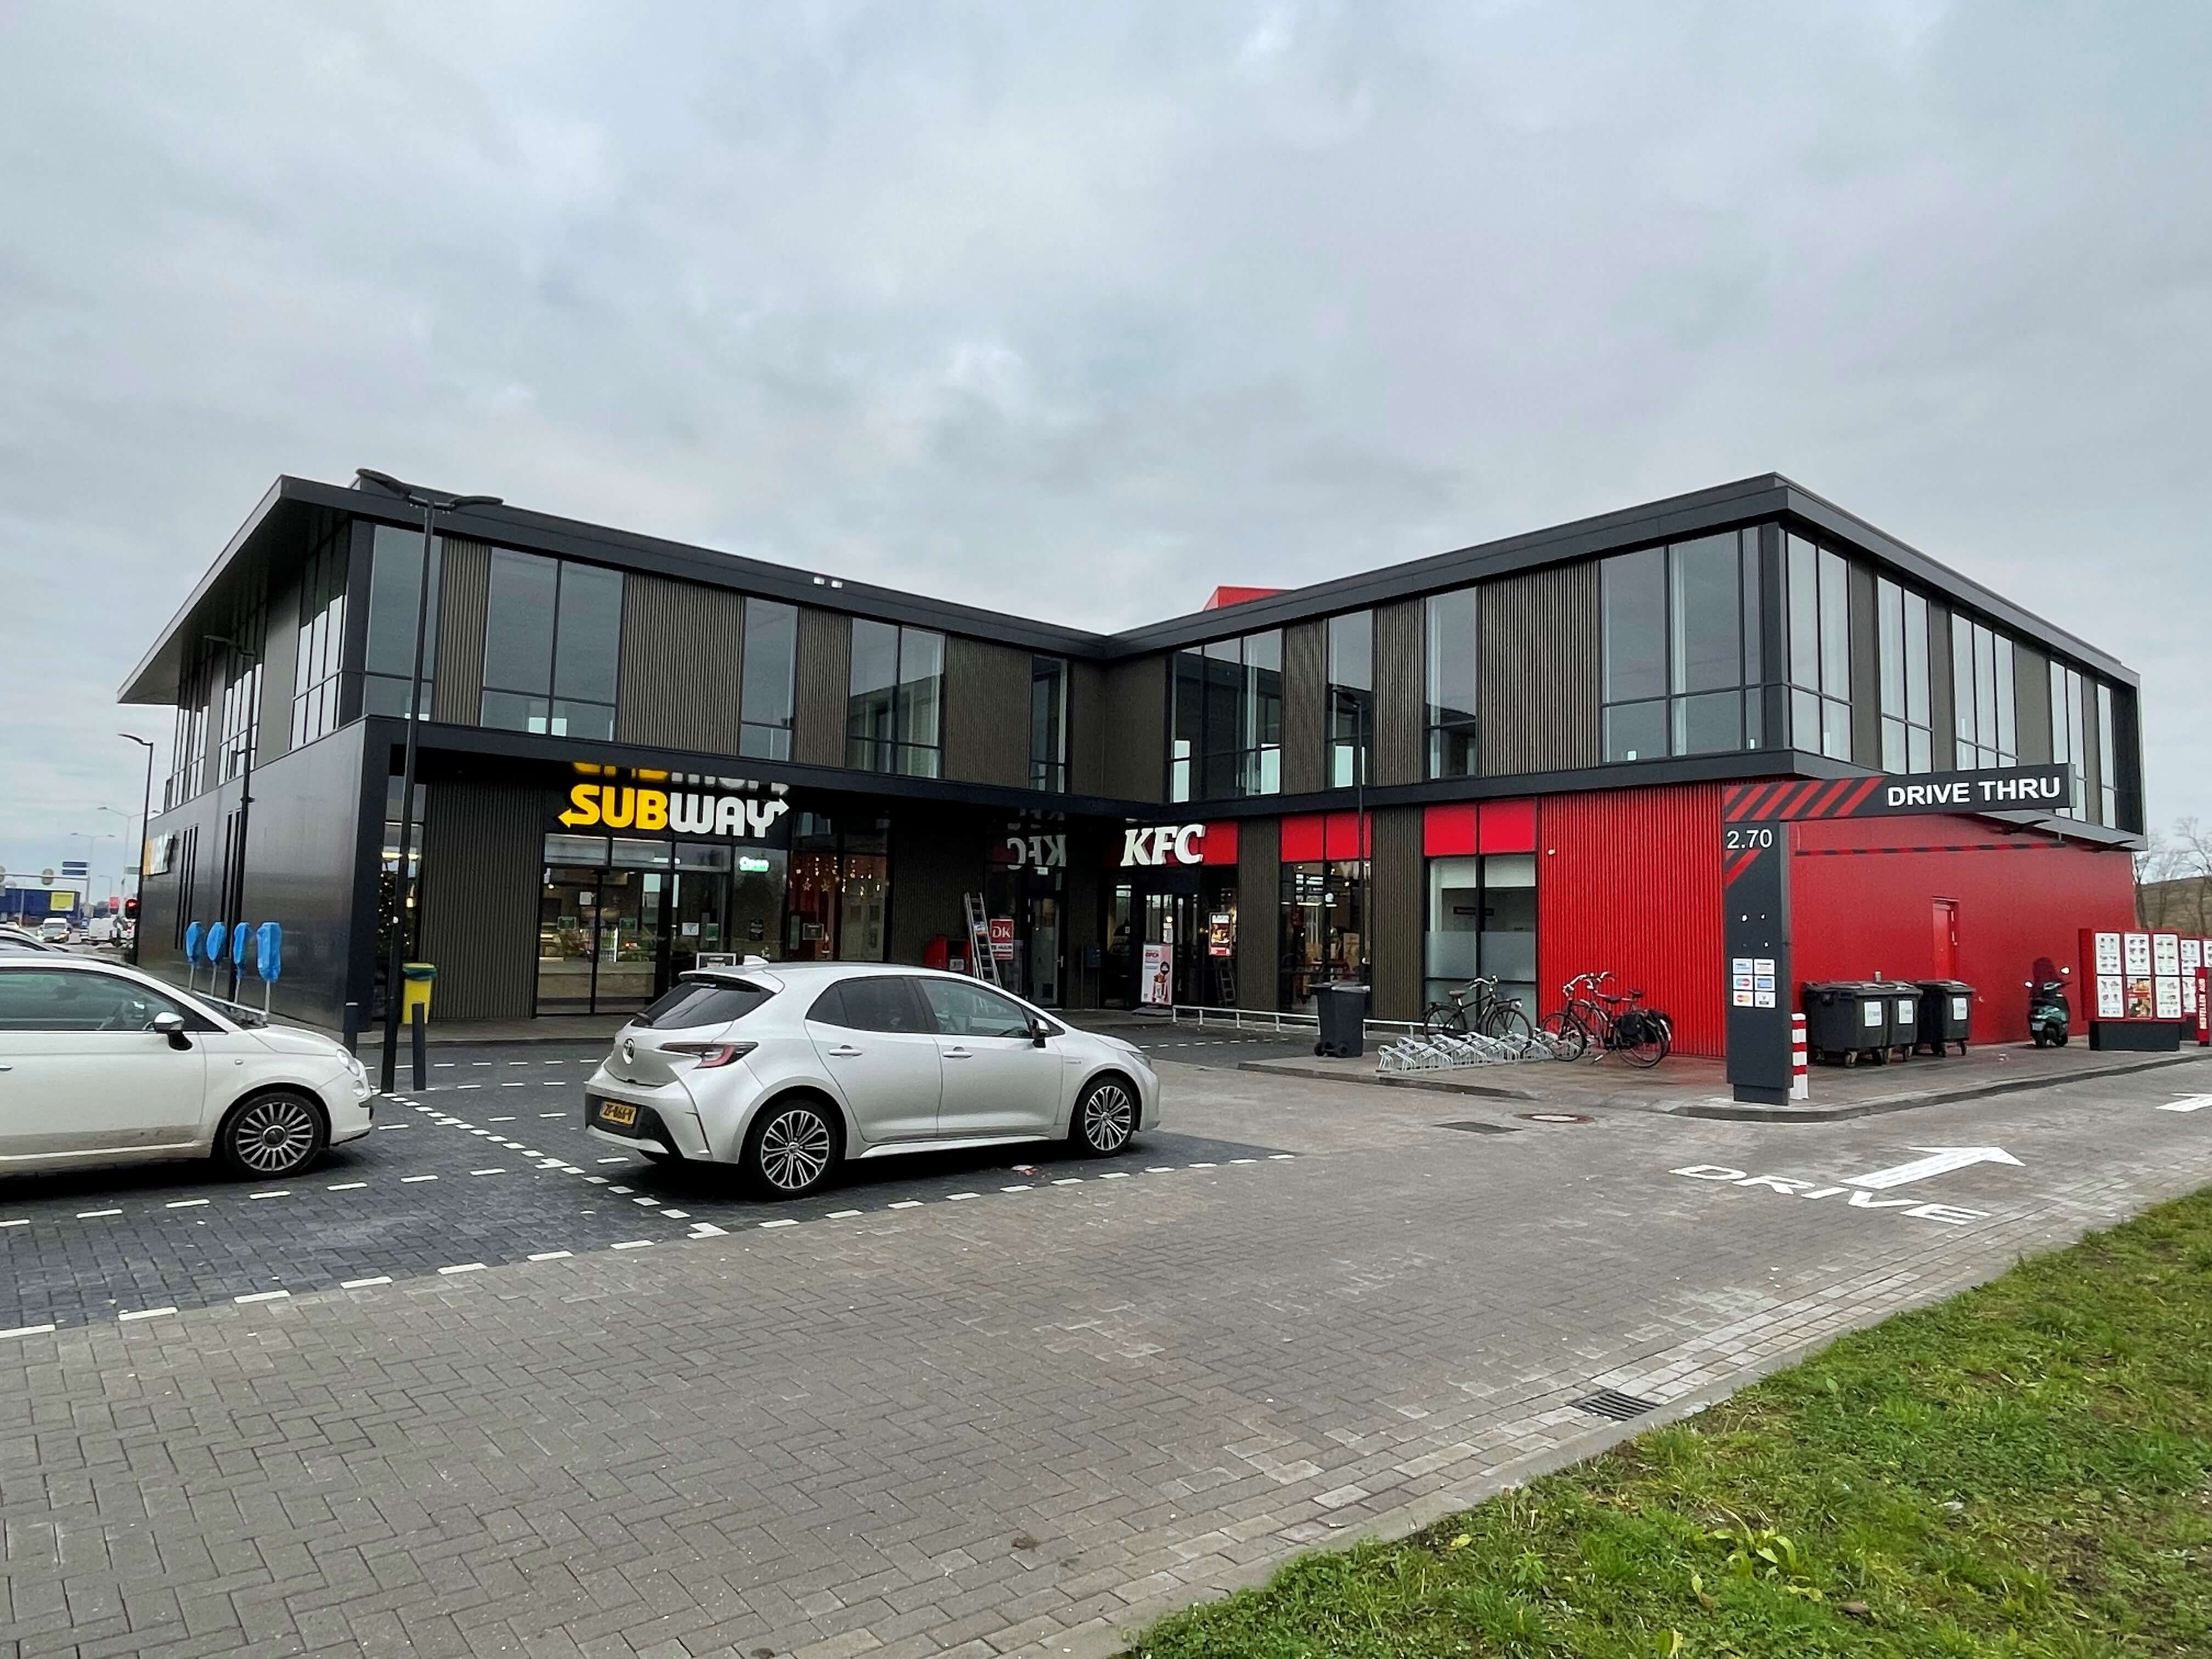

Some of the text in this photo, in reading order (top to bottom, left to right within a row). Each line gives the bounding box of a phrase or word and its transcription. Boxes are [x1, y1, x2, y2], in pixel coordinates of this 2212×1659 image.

[1887, 776, 2061, 807] DRIVE THRU
[557, 783, 790, 838] SUBWAY
[1120, 824, 1206, 867] KFC
[1726, 828, 1773, 850] 2.70
[992, 926, 1011, 938] DK
[1668, 1164, 1993, 1225] DRIVE
